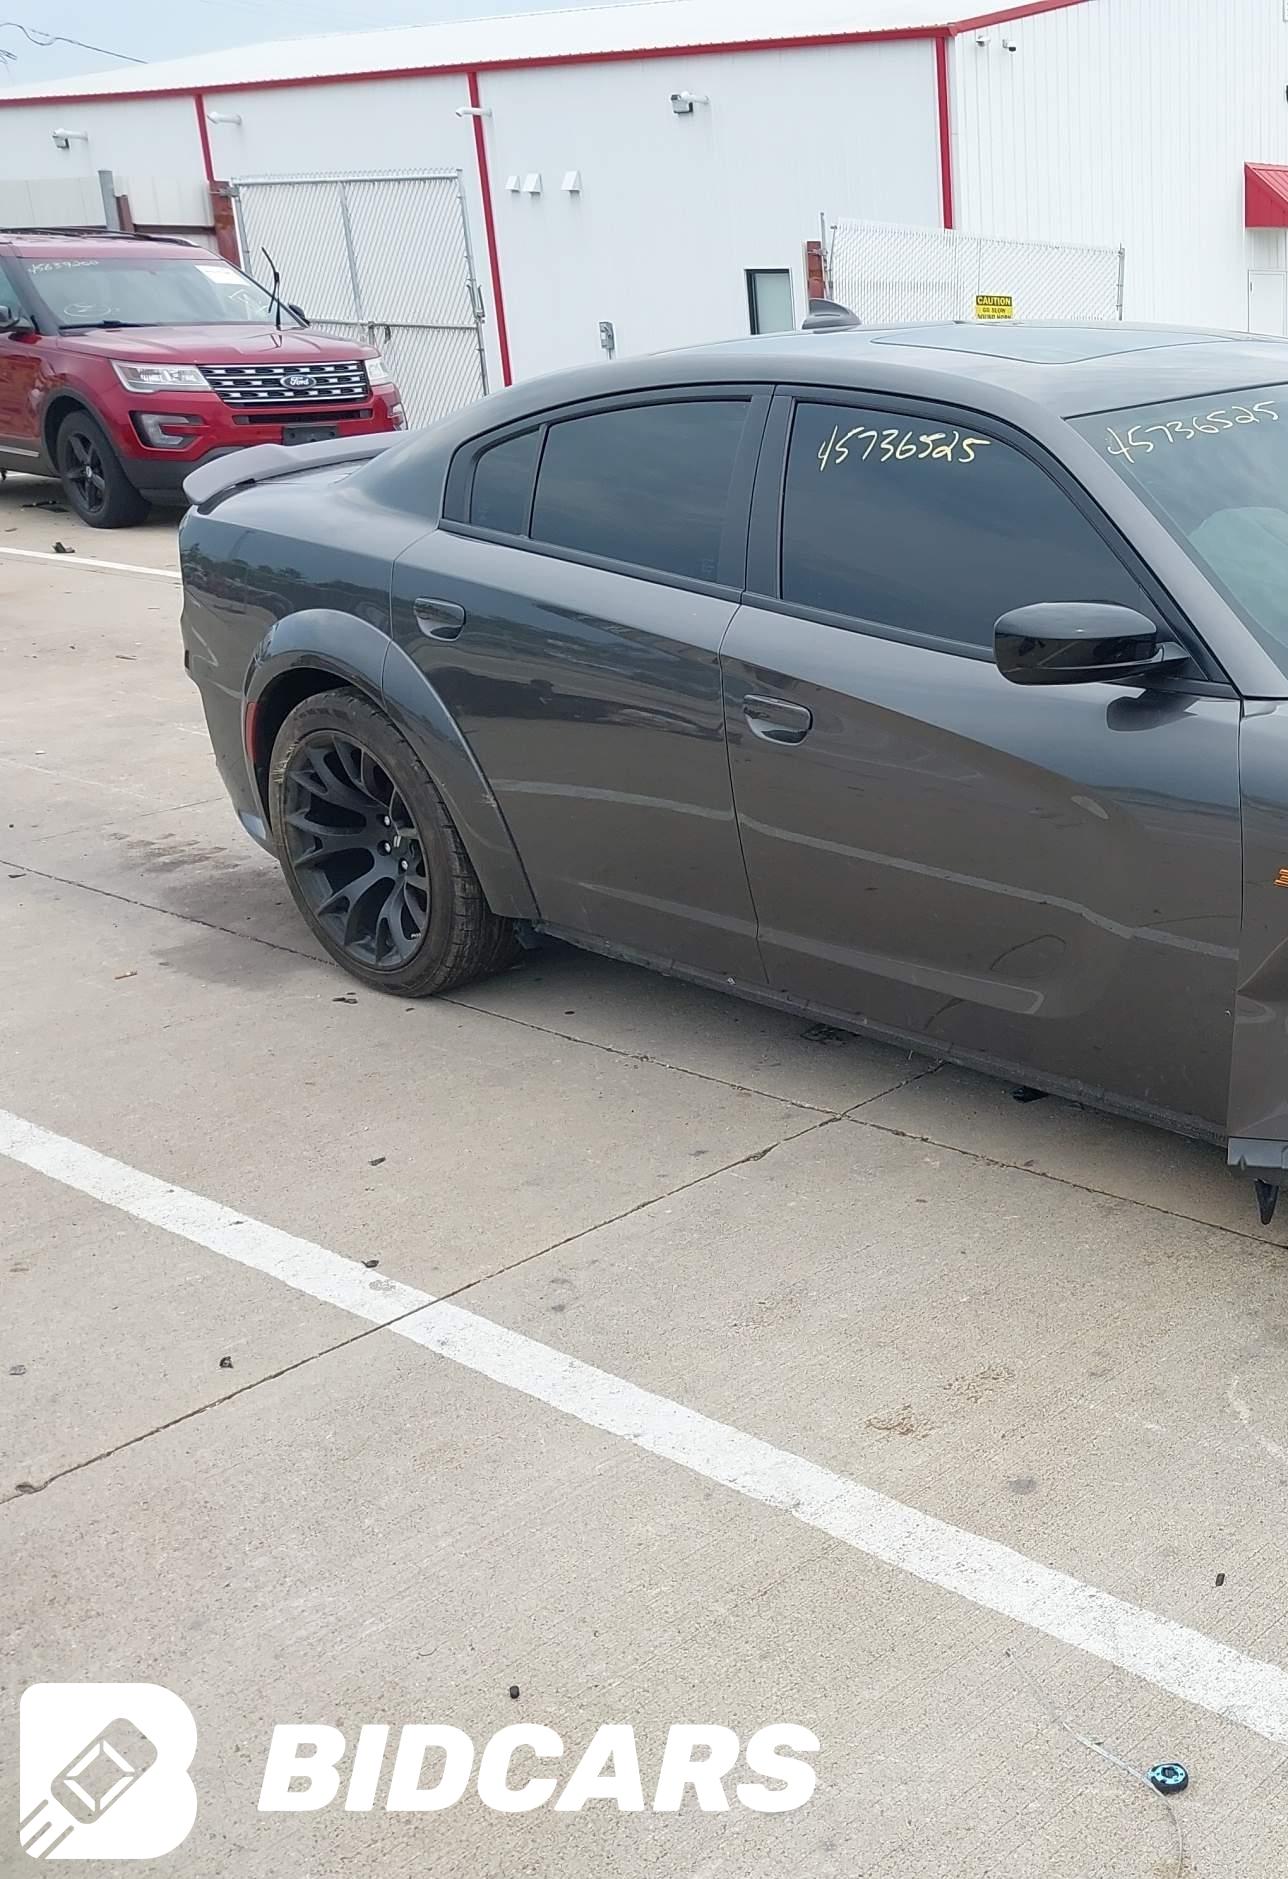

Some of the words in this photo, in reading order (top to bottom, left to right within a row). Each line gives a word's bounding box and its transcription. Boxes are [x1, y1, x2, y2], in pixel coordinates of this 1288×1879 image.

[977, 296, 1011, 305] CAUTION
[289, 376, 309, 386] Ford
[1106, 400, 1279, 464] 45736525
[817, 424, 992, 471] 45736525
